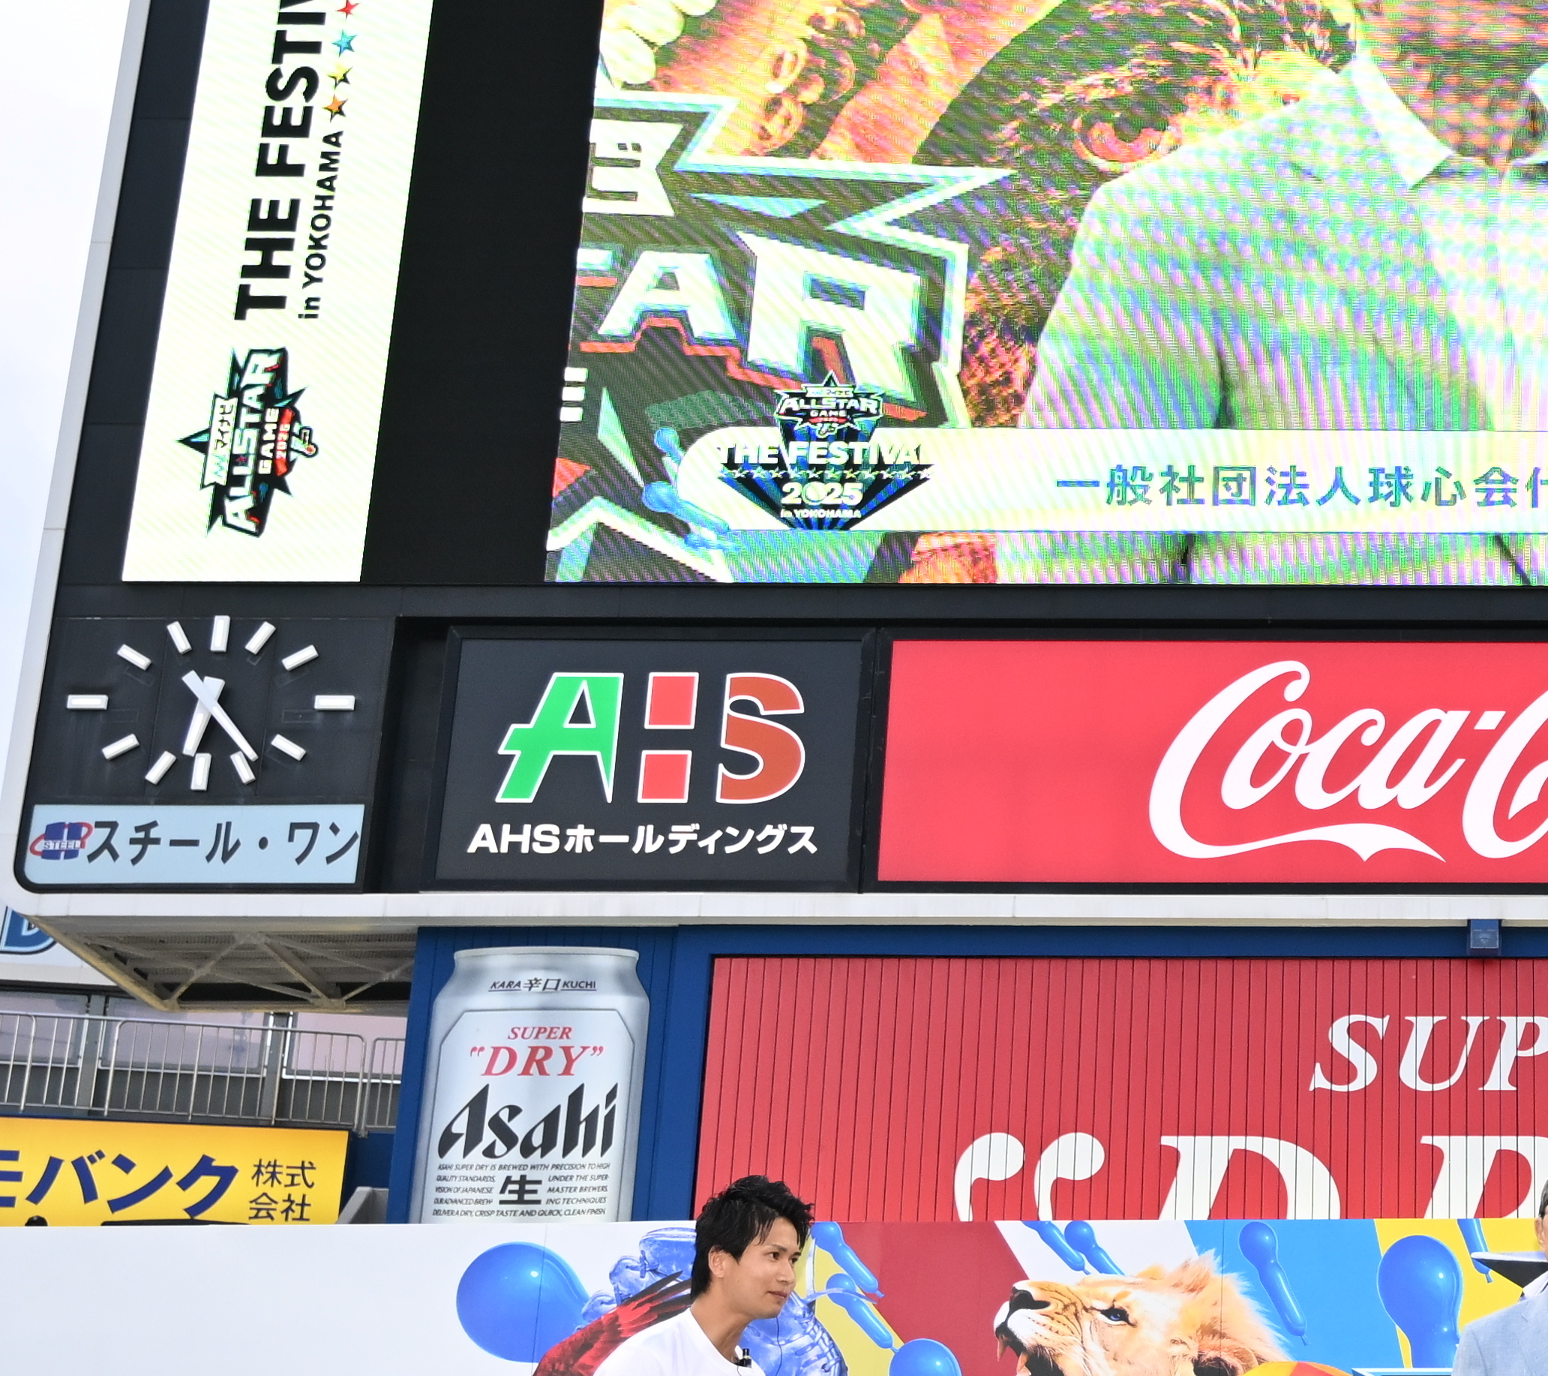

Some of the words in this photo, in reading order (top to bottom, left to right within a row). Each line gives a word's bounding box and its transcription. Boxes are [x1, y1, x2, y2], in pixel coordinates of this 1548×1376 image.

[302, 130, 344, 289] YOKOHAMA
[235, 186, 300, 322] THE
[298, 296, 318, 319] in
[258, 408, 280, 474] GAME
[719, 441, 780, 465] THE
[781, 481, 864, 506] 2025
[494, 671, 806, 805] AHS
[40, 837, 83, 851] STEEL
[92, 818, 361, 867] スチール・ワン
[467, 823, 818, 857] AHSホールディングス
[490, 978, 521, 991] KARA
[523, 978, 561, 991] 辛口
[563, 978, 596, 991] KUCHI
[508, 1027, 573, 1040] SUPER
[438, 1082, 618, 1159] Asahi
[250, 1157, 317, 1191] 株式
[499, 1174, 542, 1205] 生
[247, 1191, 313, 1223] 会社
